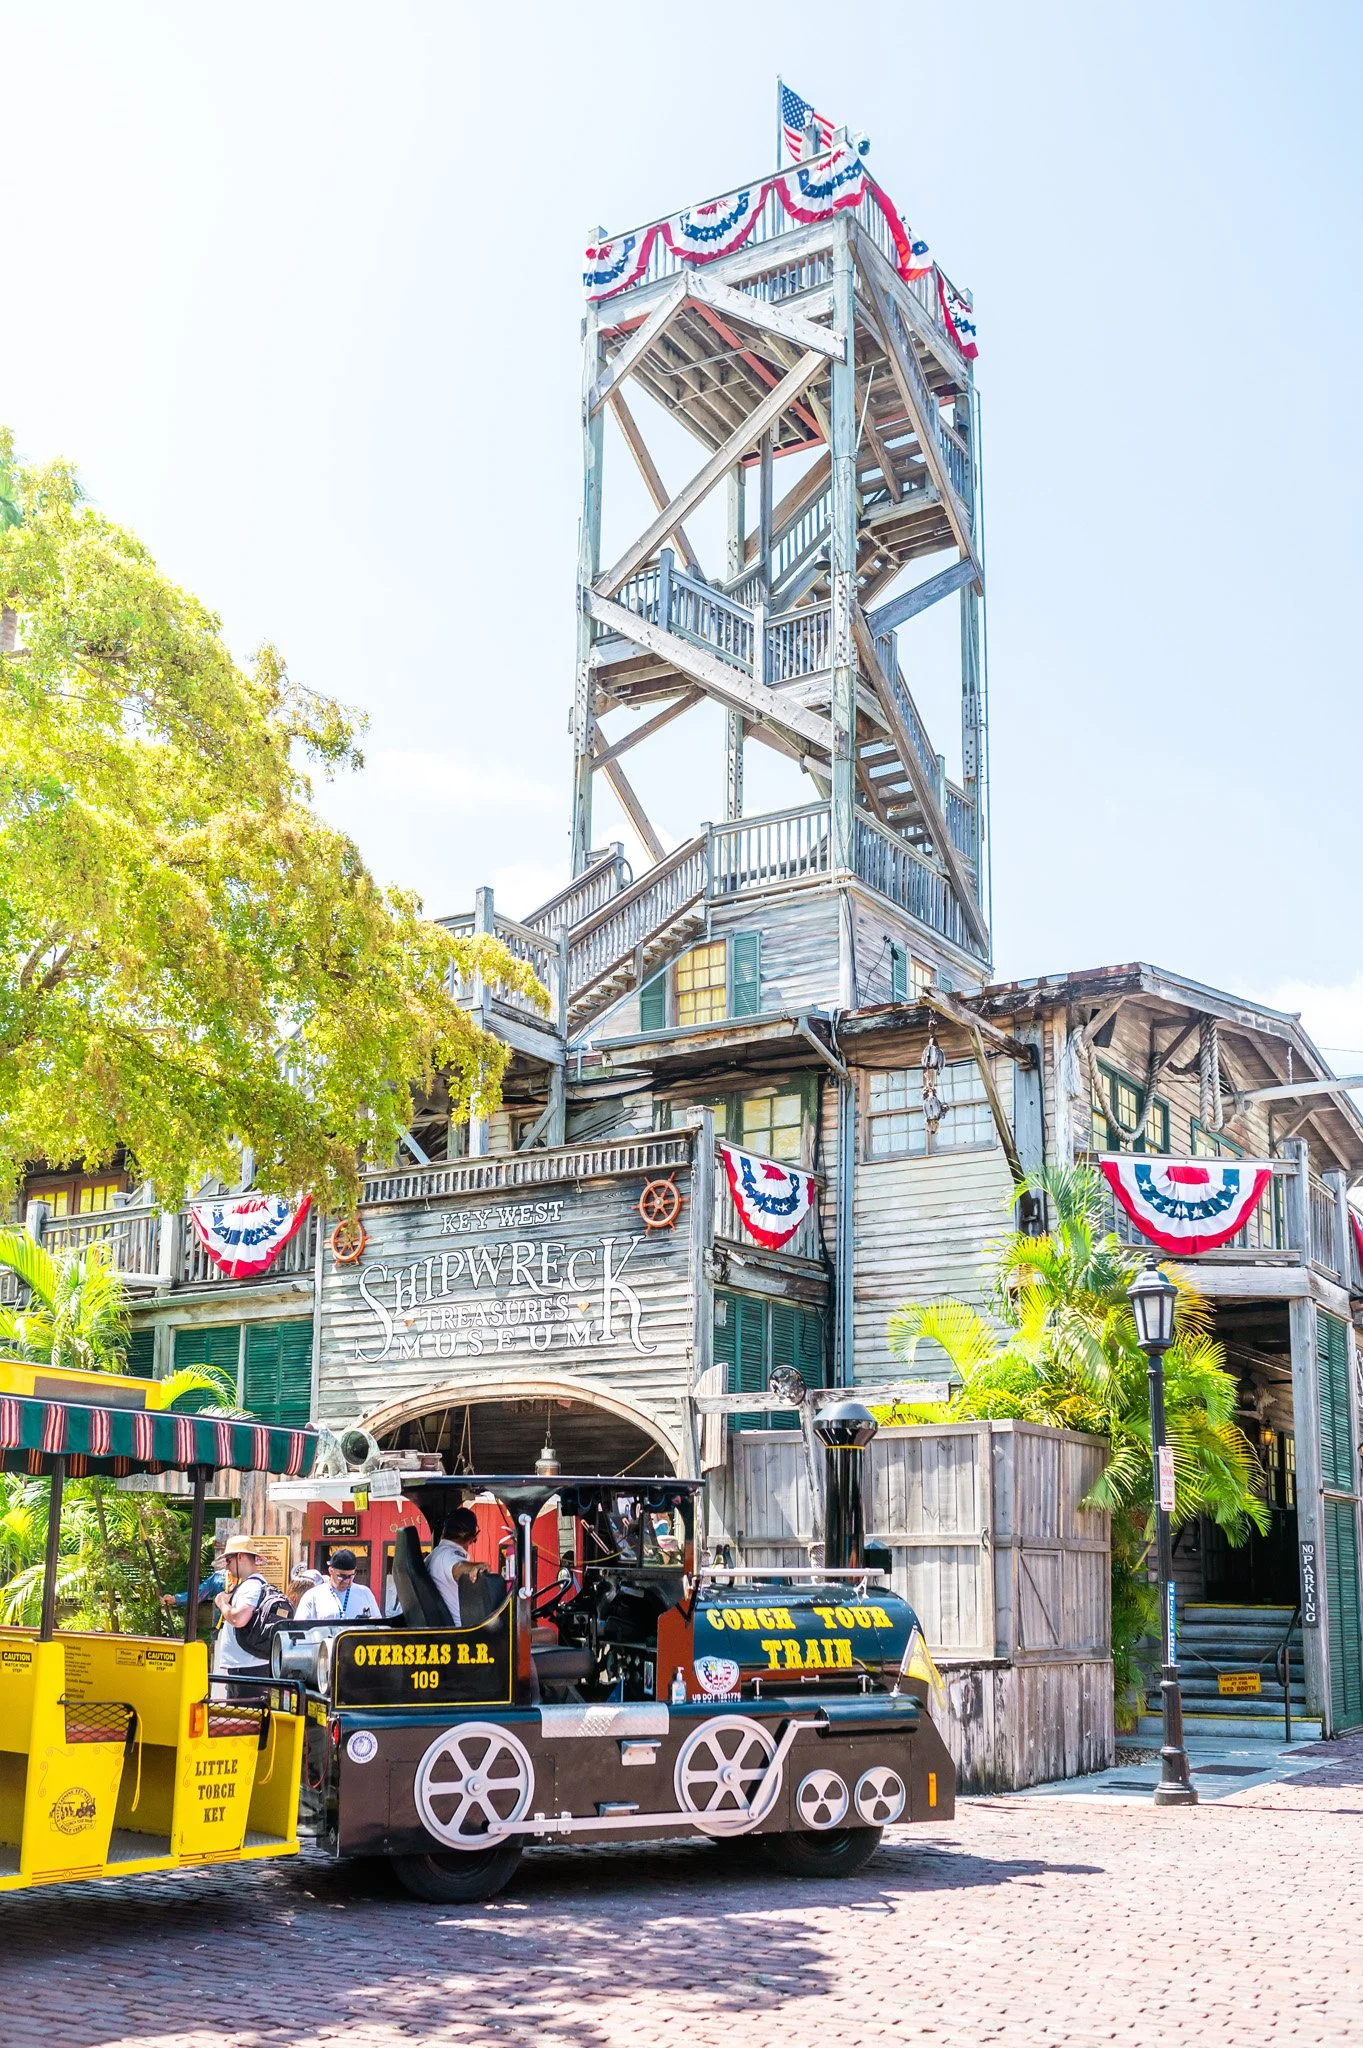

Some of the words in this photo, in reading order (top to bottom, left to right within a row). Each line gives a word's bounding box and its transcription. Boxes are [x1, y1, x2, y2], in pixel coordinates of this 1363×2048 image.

[440, 1208, 493, 1234] KEY
[496, 1200, 564, 1227] WEST
[354, 1234, 657, 1363] SHIPWRECK
[420, 1294, 570, 1332] TREASURES
[397, 1320, 595, 1360] MUSEUM
[325, 1518, 340, 1526] OPEN
[340, 1518, 355, 1526] DAILY
[1302, 1544, 1314, 1553] NO
[1303, 1555, 1316, 1622] PARKING
[706, 1607, 796, 1631] CONCH
[812, 1606, 894, 1629] TOUR
[3, 1652, 30, 1661] CAUTION
[147, 1652, 174, 1660] CAUTION
[354, 1644, 452, 1667] OVERSEAS
[456, 1643, 495, 1664] R.R.
[760, 1638, 853, 1670] TRAIN
[410, 1670, 439, 1689] 109
[195, 1759, 238, 1776] LITTLE
[198, 1783, 236, 1800] TORCH
[203, 1806, 226, 1824] KEY
